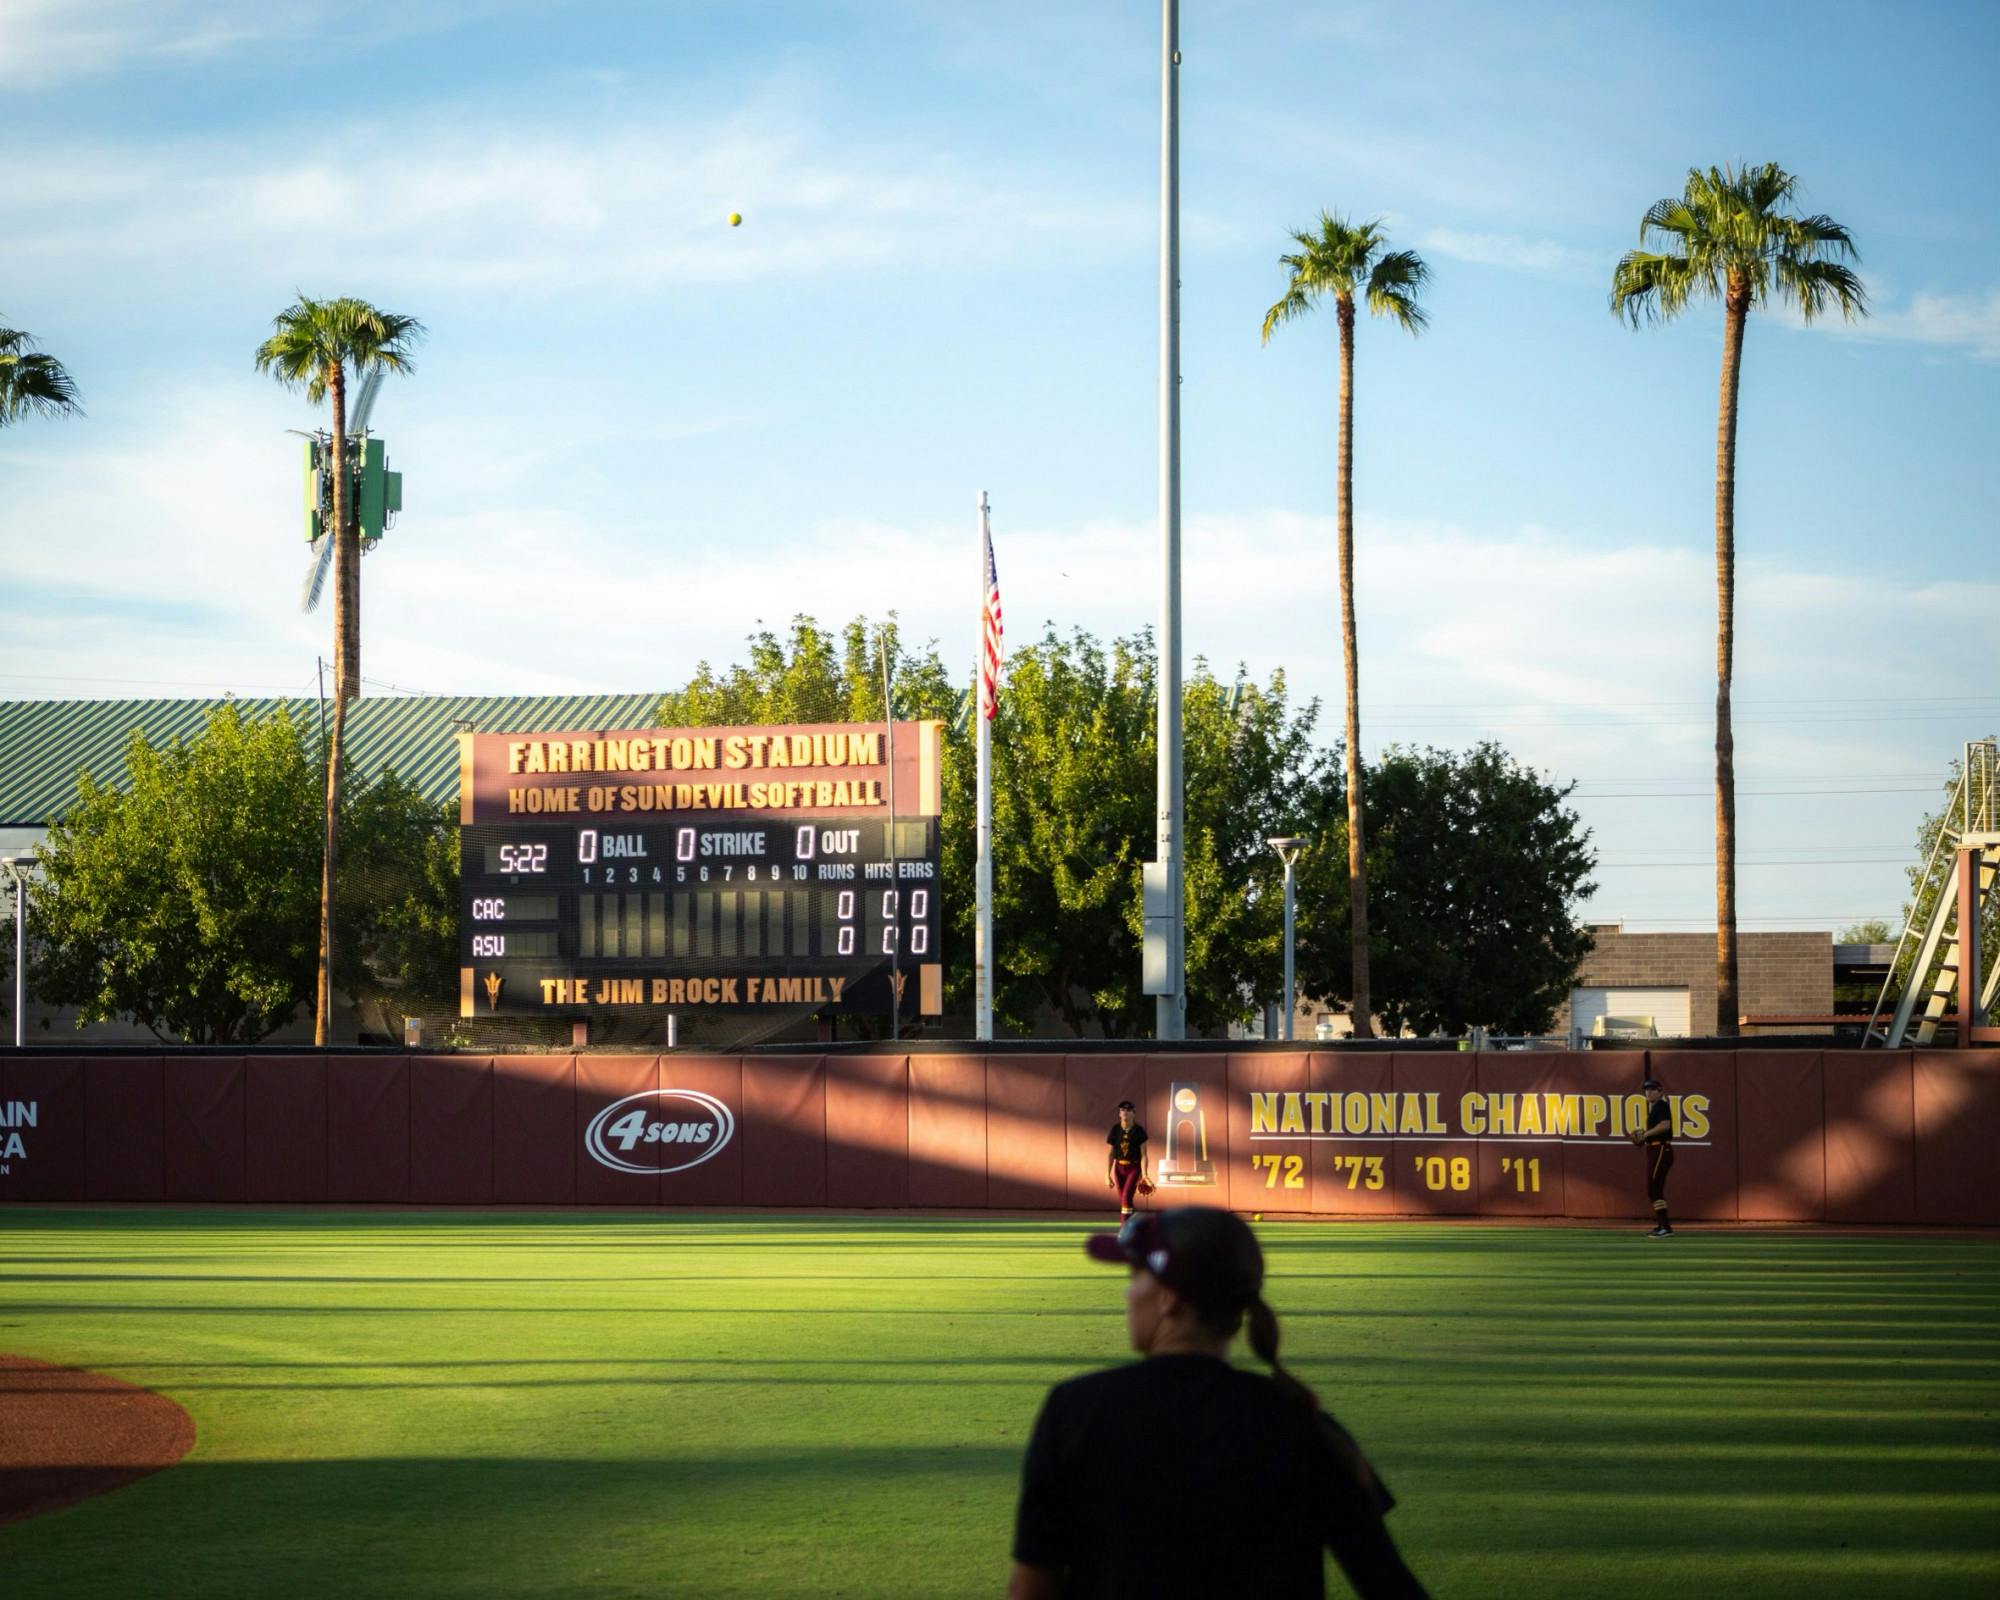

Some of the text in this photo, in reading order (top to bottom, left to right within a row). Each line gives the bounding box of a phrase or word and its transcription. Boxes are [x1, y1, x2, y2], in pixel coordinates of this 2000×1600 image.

[508, 733, 880, 774] FARRINGTON STADIUM
[508, 787, 581, 813] HOME
[588, 787, 617, 812] OF
[750, 780, 880, 808] SOFTBALL
[500, 844, 547, 873] 5:22
[579, 826, 860, 863] 0 BALL 0 STRIKE 0 OUT
[583, 868, 590, 883] 1
[606, 867, 615, 883] 2
[629, 867, 638, 883] 3
[652, 867, 661, 882] 4
[676, 866, 685, 882] 5
[700, 866, 708, 881] 6
[723, 865, 733, 881] 7
[747, 865, 756, 881] 8
[771, 864, 780, 880] 9
[792, 864, 807, 880] 10
[818, 864, 855, 880] RUNS
[898, 862, 934, 878] ERRS
[472, 899, 505, 919] CAC
[838, 891, 854, 919] 0
[911, 890, 928, 919] 0
[472, 936, 505, 956] ASU
[838, 927, 854, 954] 0
[911, 926, 928, 954] 0
[540, 977, 846, 1005] THE JIM BROCK FAMILY
[1250, 1091, 1448, 1134] NATIONAL
[608, 1110, 713, 1151] 4 SONS
[1252, 1155, 1540, 1192] '72 '73 '08 '11
